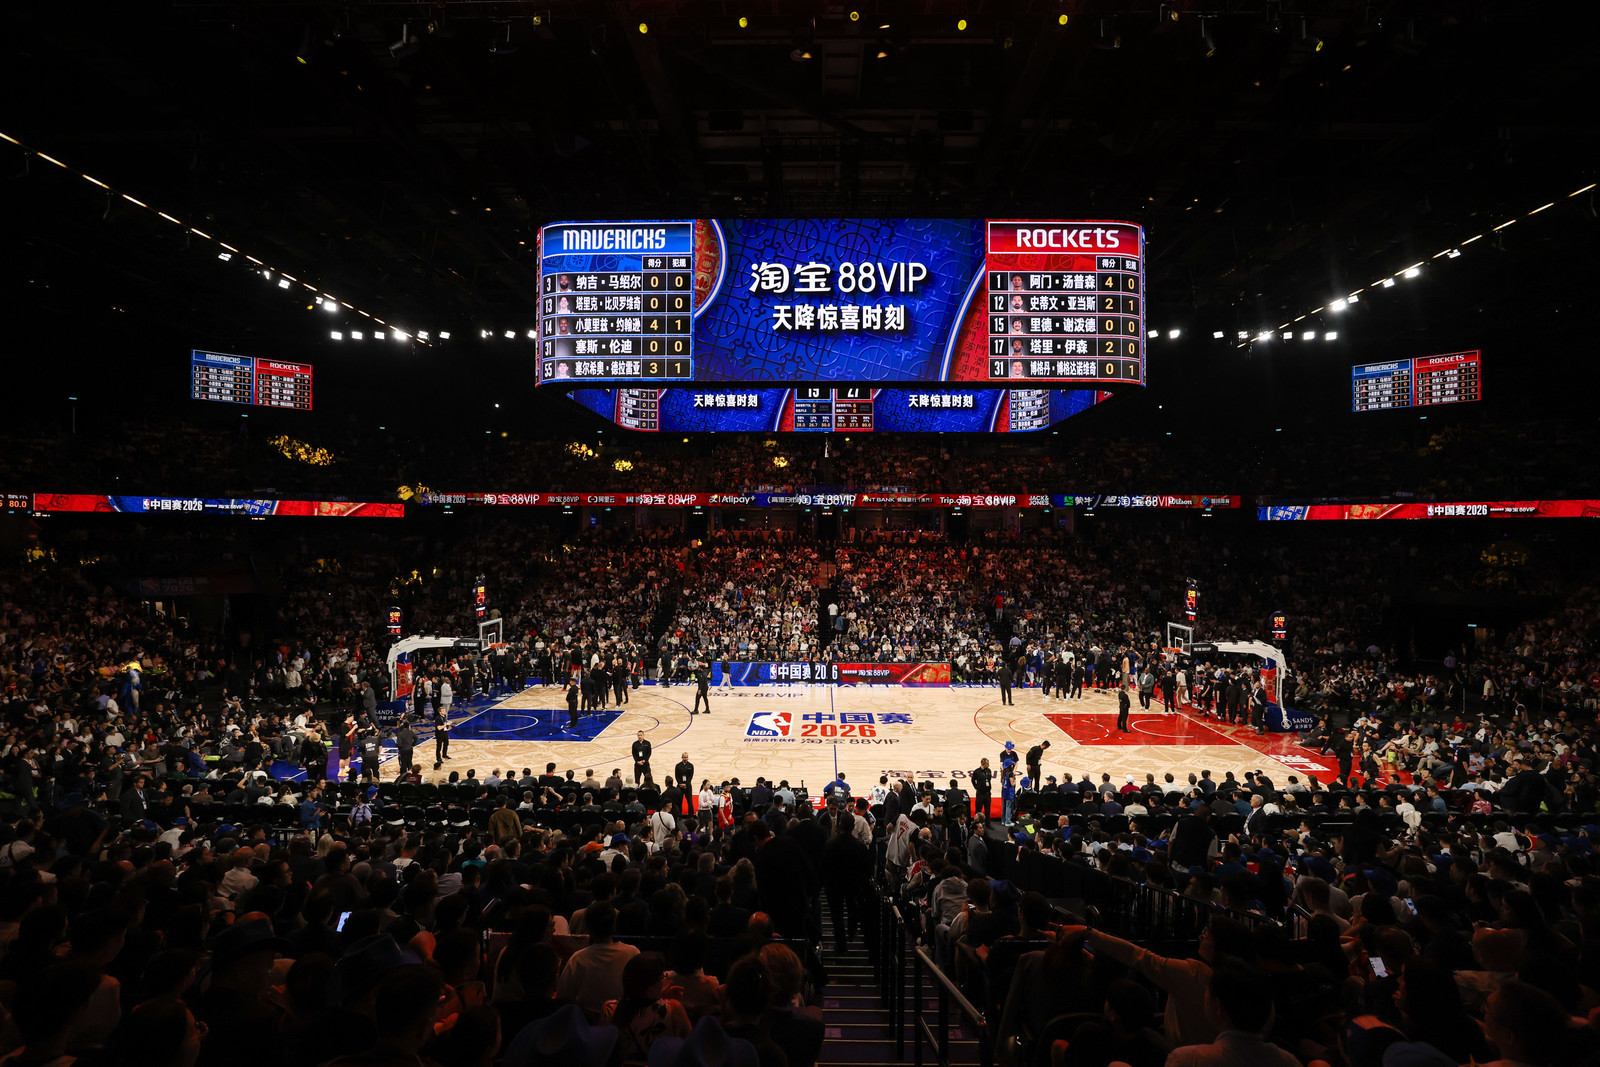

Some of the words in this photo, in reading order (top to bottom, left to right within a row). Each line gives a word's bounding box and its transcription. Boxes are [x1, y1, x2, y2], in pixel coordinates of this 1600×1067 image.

[563, 229, 665, 250] MAVERICKS
[1017, 228, 1119, 248] ROCKETS
[648, 259, 661, 267] 得分
[1102, 259, 1115, 268] 得分
[547, 278, 551, 291] 3
[576, 275, 641, 290] 纳吉·马绍尔
[651, 277, 658, 287] 0
[675, 277, 683, 287] 0
[749, 261, 927, 293] 淘宝88VIP
[996, 275, 1000, 288] 1
[1030, 274, 1095, 289] 阿门·汤普森
[1105, 277, 1113, 287] 4
[1128, 278, 1134, 289] 0
[545, 299, 552, 312] 13
[650, 298, 658, 308] 0
[675, 298, 683, 308] 0
[994, 297, 1004, 310] 12
[1030, 296, 1095, 310] 史蒂文·亚当斯
[1106, 298, 1113, 309] 2
[1129, 300, 1134, 310] 1
[772, 304, 905, 330] 天降惊喜时刻
[545, 321, 552, 334] 14
[650, 320, 658, 330] 4
[675, 320, 681, 330] 1
[994, 318, 1004, 331] 15
[1106, 320, 1113, 331] 0
[1129, 322, 1134, 332] 0
[545, 342, 552, 355] 31
[576, 340, 632, 354] 塞斯·伦迪
[650, 341, 658, 352] 0
[675, 341, 682, 352] 0
[994, 340, 1004, 353] 17
[1030, 339, 1088, 354] 塔里·伊森
[1106, 342, 1113, 352] 2
[1129, 343, 1135, 354] 0
[206, 354, 240, 364] MAVERICKS
[1430, 355, 1464, 364] ROCKETS
[270, 363, 300, 371] ROCKETS
[544, 363, 552, 377] 55
[650, 363, 658, 373] 3
[675, 363, 681, 373] 1
[995, 362, 1004, 375] 31
[1106, 363, 1114, 374] 0
[1129, 365, 1134, 375] 1
[1365, 363, 1398, 372] MAVERICKS
[694, 394, 758, 407] 天降惊喜时刻
[908, 394, 973, 408] 天降惊喜时刻
[484, 494, 540, 504] 淘宝88VIP
[1075, 496, 1092, 505] 蒙牛
[778, 664, 838, 680] 中国赛206
[802, 712, 914, 724] 中国赛
[801, 724, 877, 737] 2026
[897, 828, 905, 840] 7
